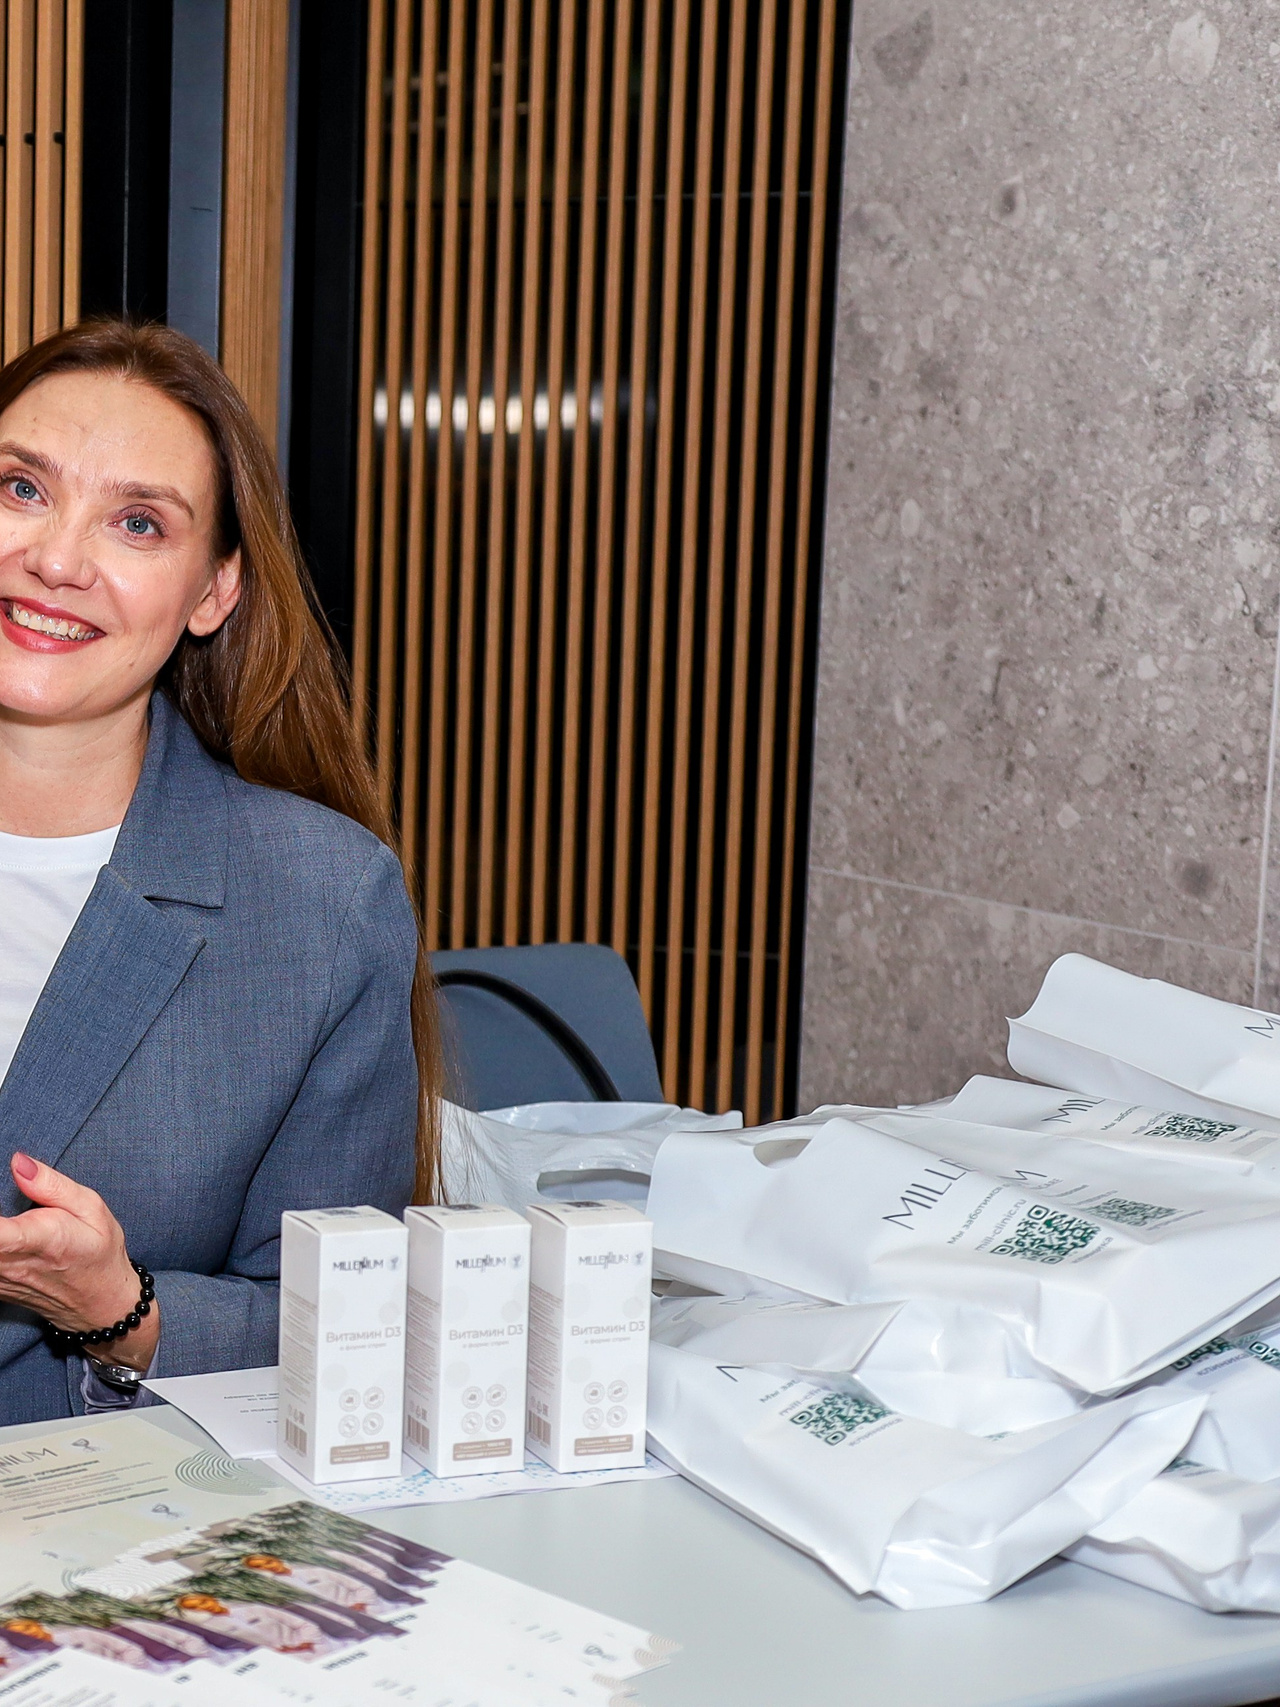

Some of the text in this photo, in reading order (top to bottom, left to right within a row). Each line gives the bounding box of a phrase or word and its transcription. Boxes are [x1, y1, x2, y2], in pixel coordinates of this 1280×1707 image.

[975, 1199, 1027, 1251] mill-clinic.ru
[947, 1230, 964, 1245] Мы
[326, 1326, 402, 1343] Витамин D3
[449, 1324, 524, 1341] Витамин D3
[571, 1320, 645, 1337] Витамин D3
